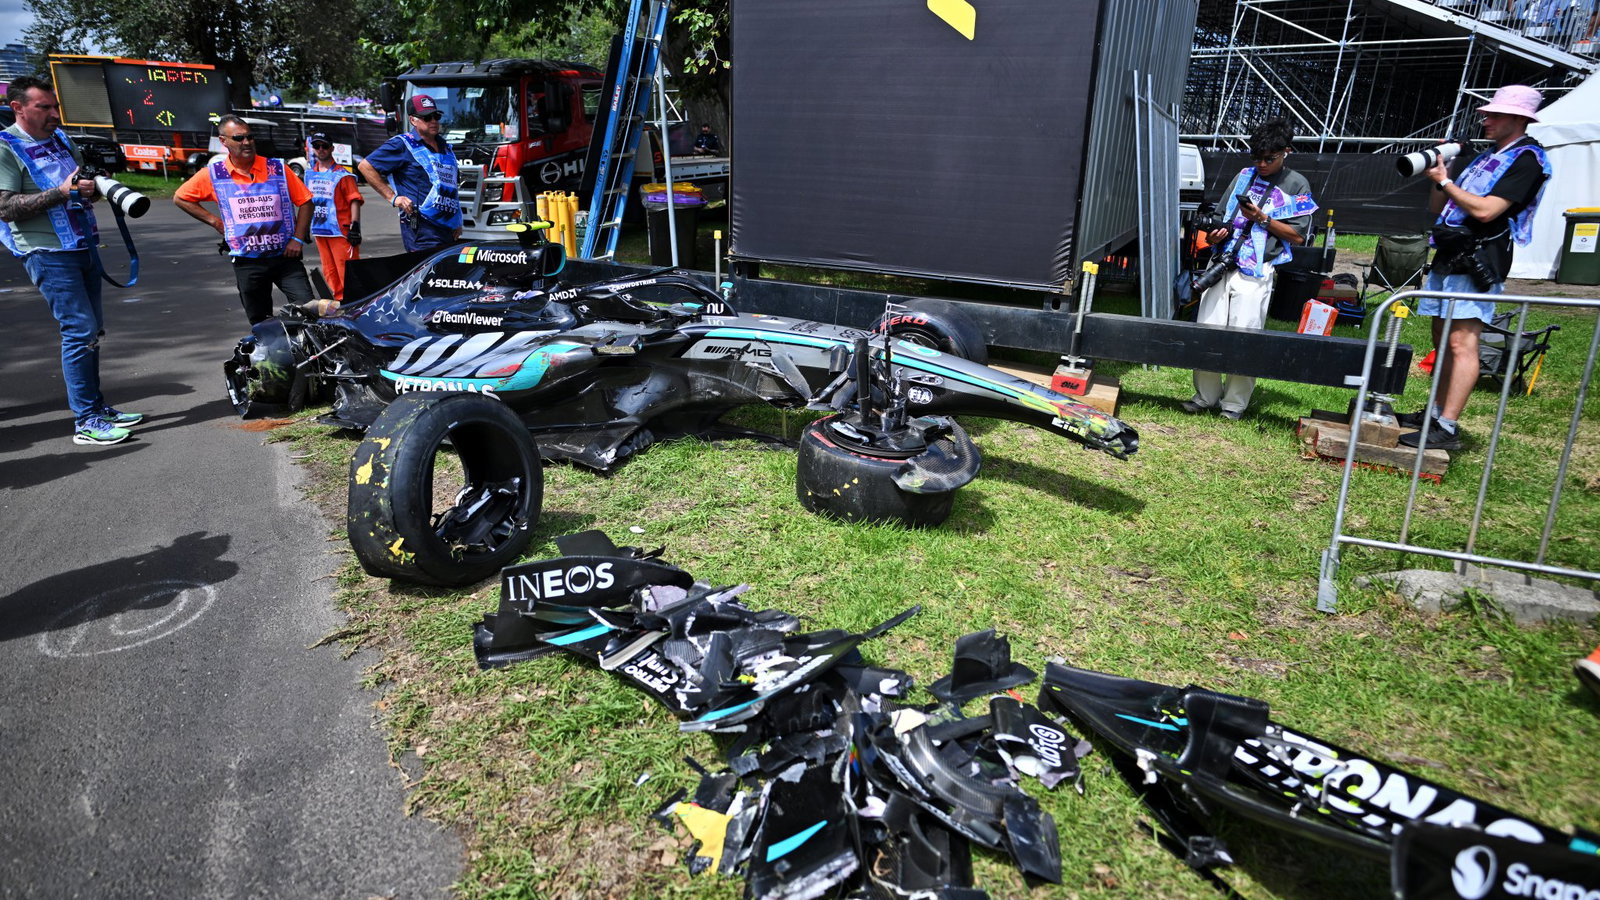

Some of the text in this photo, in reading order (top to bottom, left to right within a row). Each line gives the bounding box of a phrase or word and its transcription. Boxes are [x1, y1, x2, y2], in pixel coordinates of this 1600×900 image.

[132, 147, 159, 157] Coates
[239, 211, 279, 220] PERSONNEL
[240, 205, 275, 214] RECOVERY
[241, 233, 285, 247] COURSE
[246, 244, 284, 252] ACCESS
[476, 249, 528, 265] Microsoft
[434, 278, 475, 290] SOLERA
[612, 278, 657, 293] CROWDSTRIKE
[548, 291, 569, 302] AMD
[706, 302, 724, 315] nu
[442, 310, 504, 327] TeamViewer
[727, 346, 772, 358] AMG
[910, 386, 931, 402] FIA
[506, 562, 615, 602] INEOS
